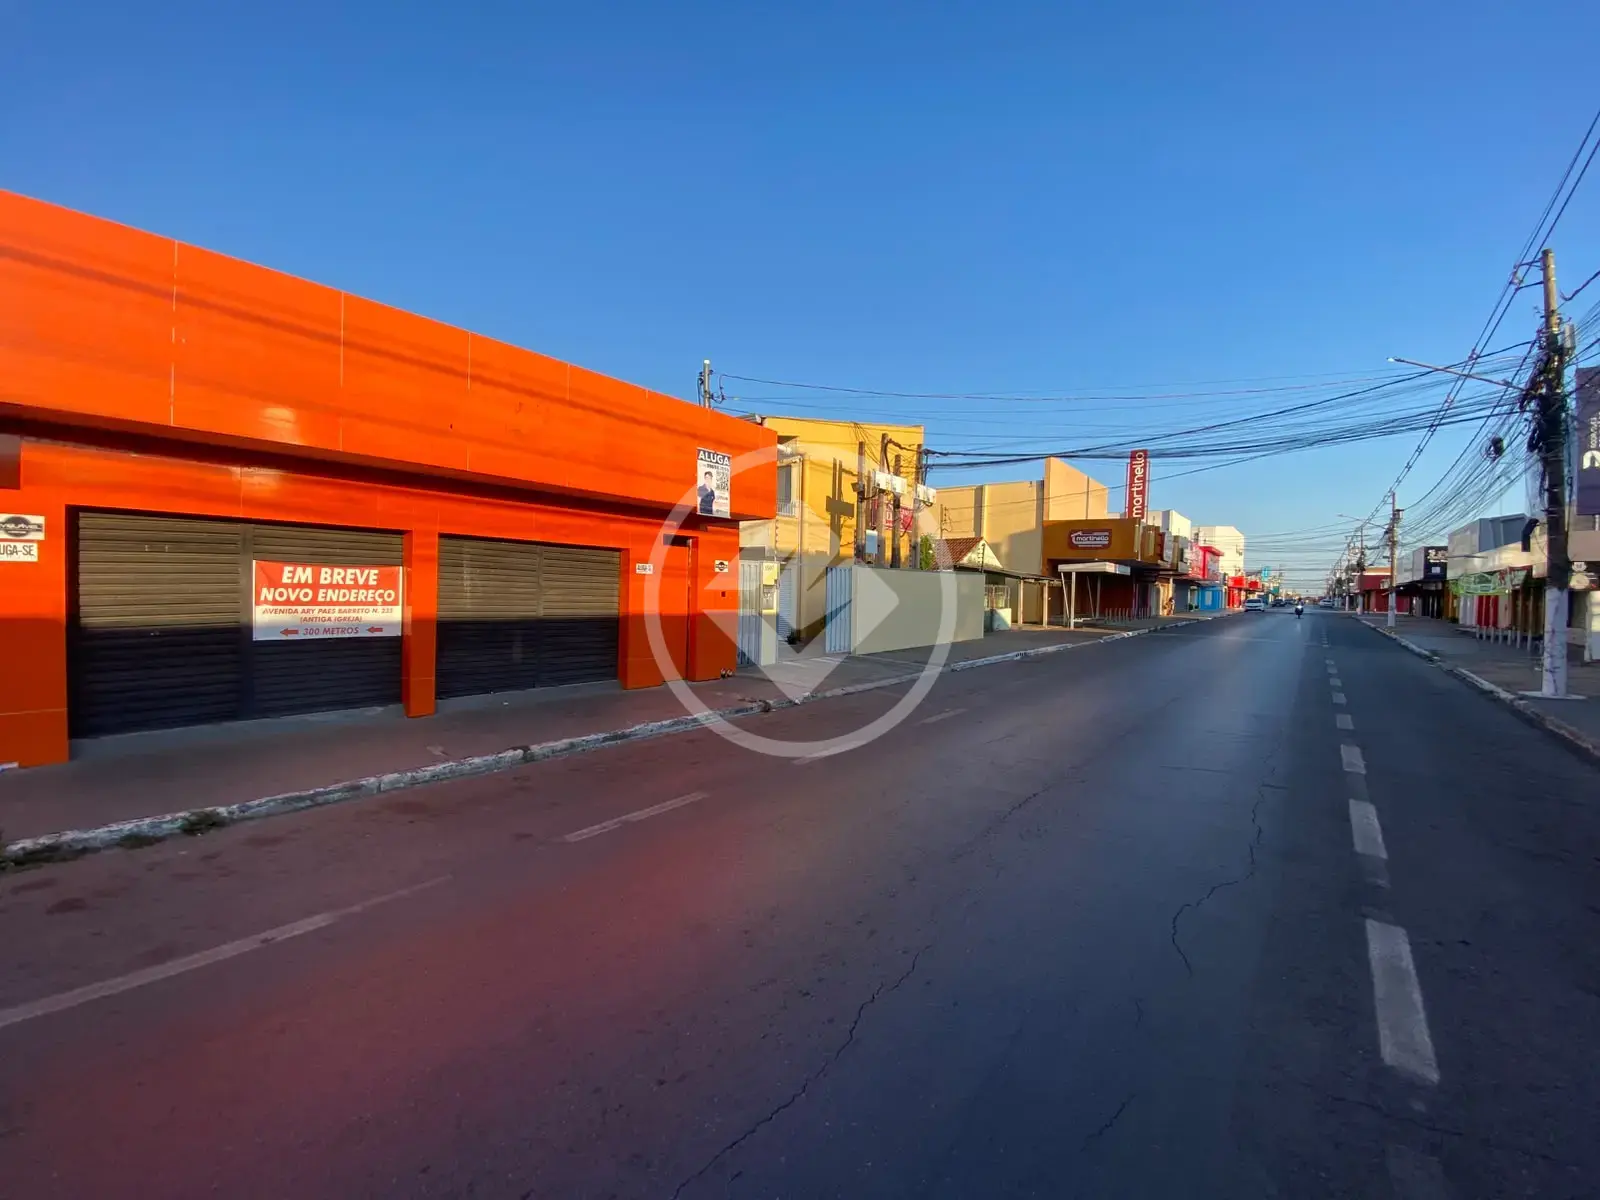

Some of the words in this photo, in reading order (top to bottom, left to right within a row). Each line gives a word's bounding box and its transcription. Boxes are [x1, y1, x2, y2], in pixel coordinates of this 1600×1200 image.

[698, 450, 730, 466] ALUGA
[1132, 452, 1145, 518] martinello
[281, 566, 313, 584] EM
[319, 567, 379, 585] BREVE
[260, 587, 313, 602] NOVO
[317, 588, 396, 606] ENDEREÇO
[262, 607, 299, 615] AVENIDA
[300, 607, 316, 615] ARY
[303, 627, 320, 635] 300
[322, 626, 359, 635] METROS
